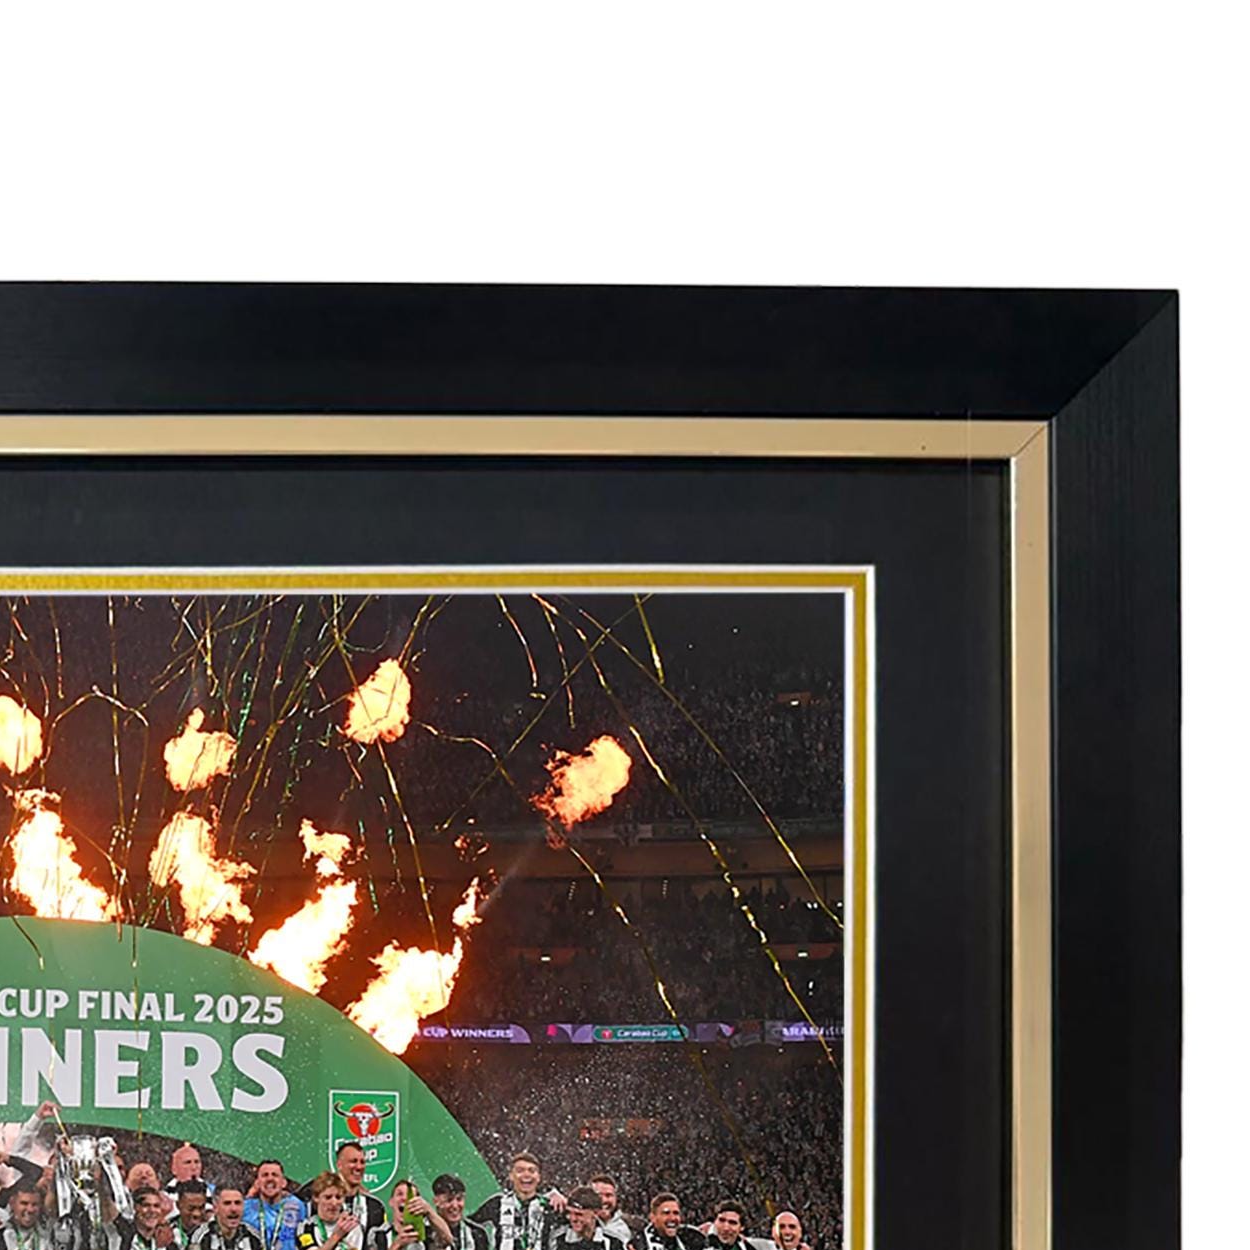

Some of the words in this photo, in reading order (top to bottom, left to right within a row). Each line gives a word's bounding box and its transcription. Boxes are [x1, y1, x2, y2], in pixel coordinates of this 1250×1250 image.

[78, 990, 186, 1022] FINAL
[193, 994, 284, 1025] 2025
[423, 1027, 449, 1038] CUP
[450, 1028, 514, 1038] WINNERS
